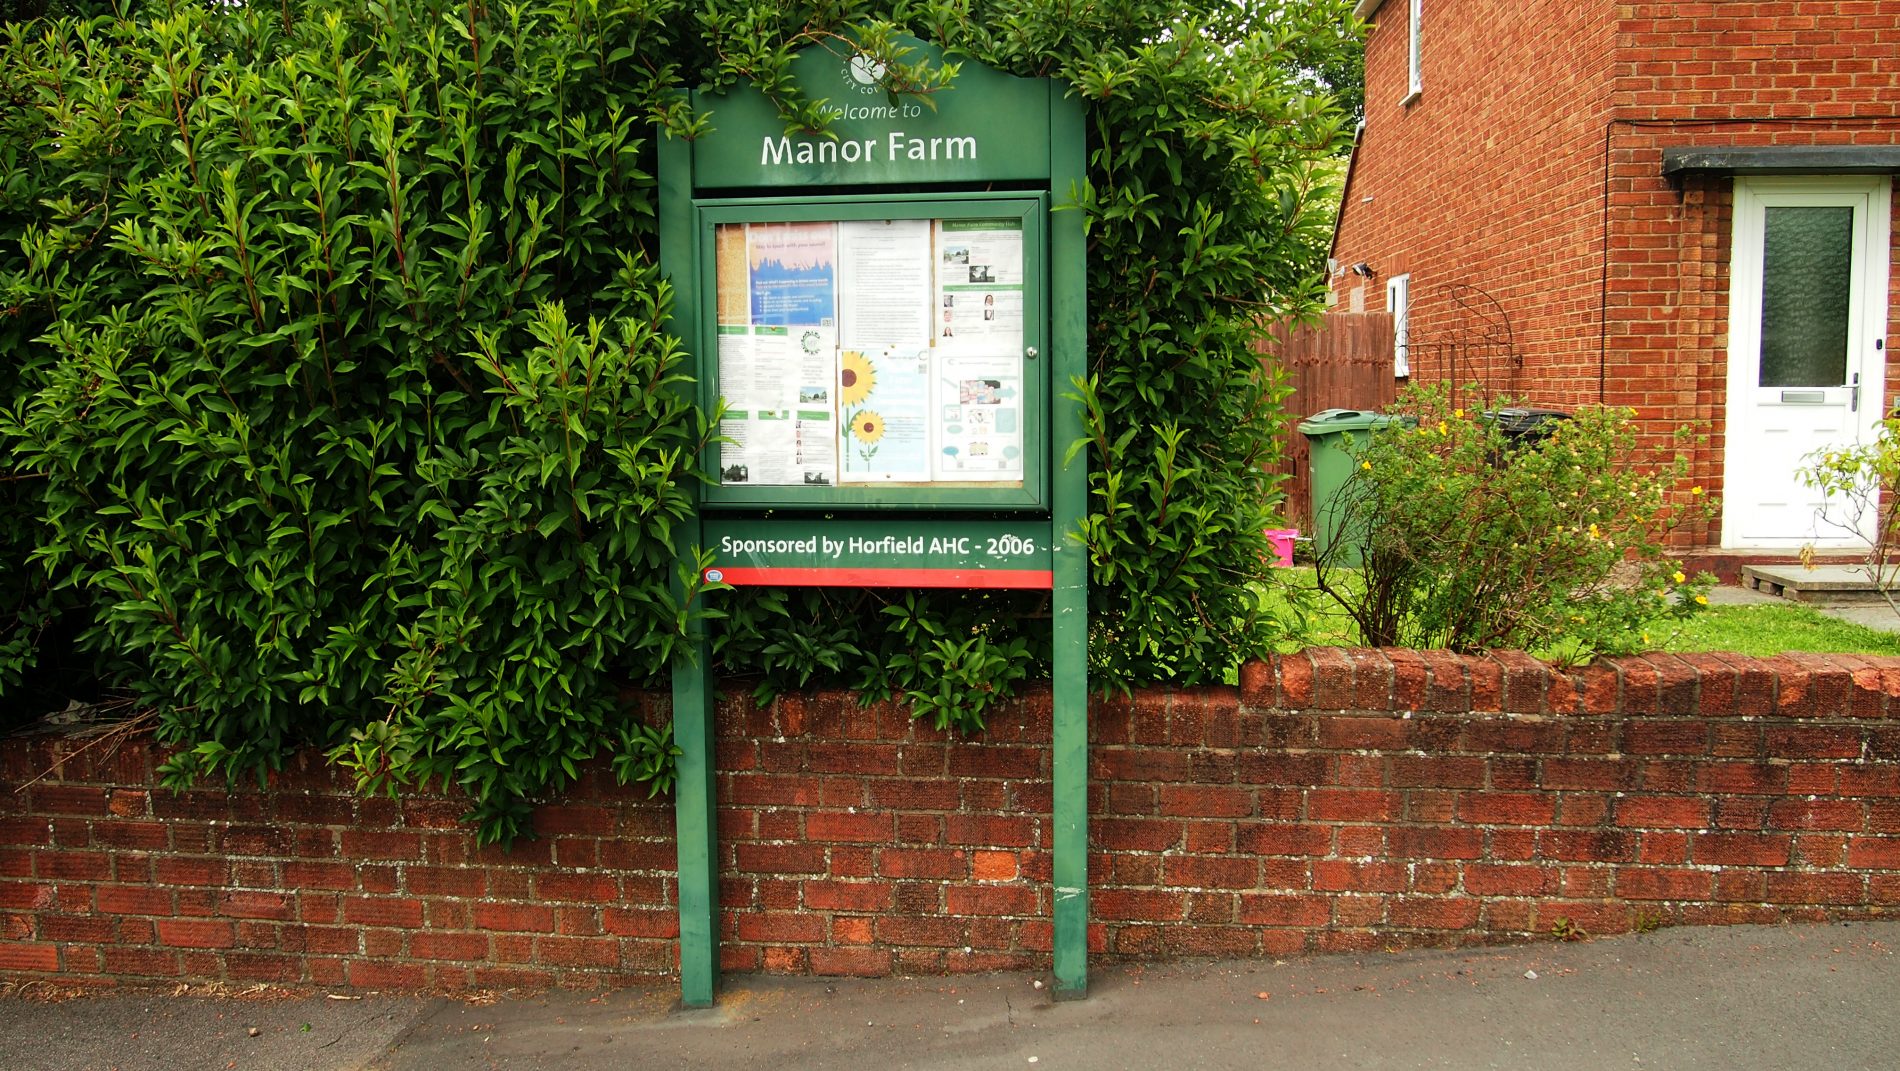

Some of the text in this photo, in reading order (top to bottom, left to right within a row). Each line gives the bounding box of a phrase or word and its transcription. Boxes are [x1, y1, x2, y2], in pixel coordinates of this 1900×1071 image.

[840, 68, 858, 90] CITY
[902, 102, 921, 118] to
[761, 131, 977, 166] Manor Farm
[721, 536, 815, 557] Sponsored
[822, 536, 844, 558] by
[849, 536, 924, 554] Horfield
[929, 537, 970, 555] AHC
[987, 538, 1035, 555] 2006
